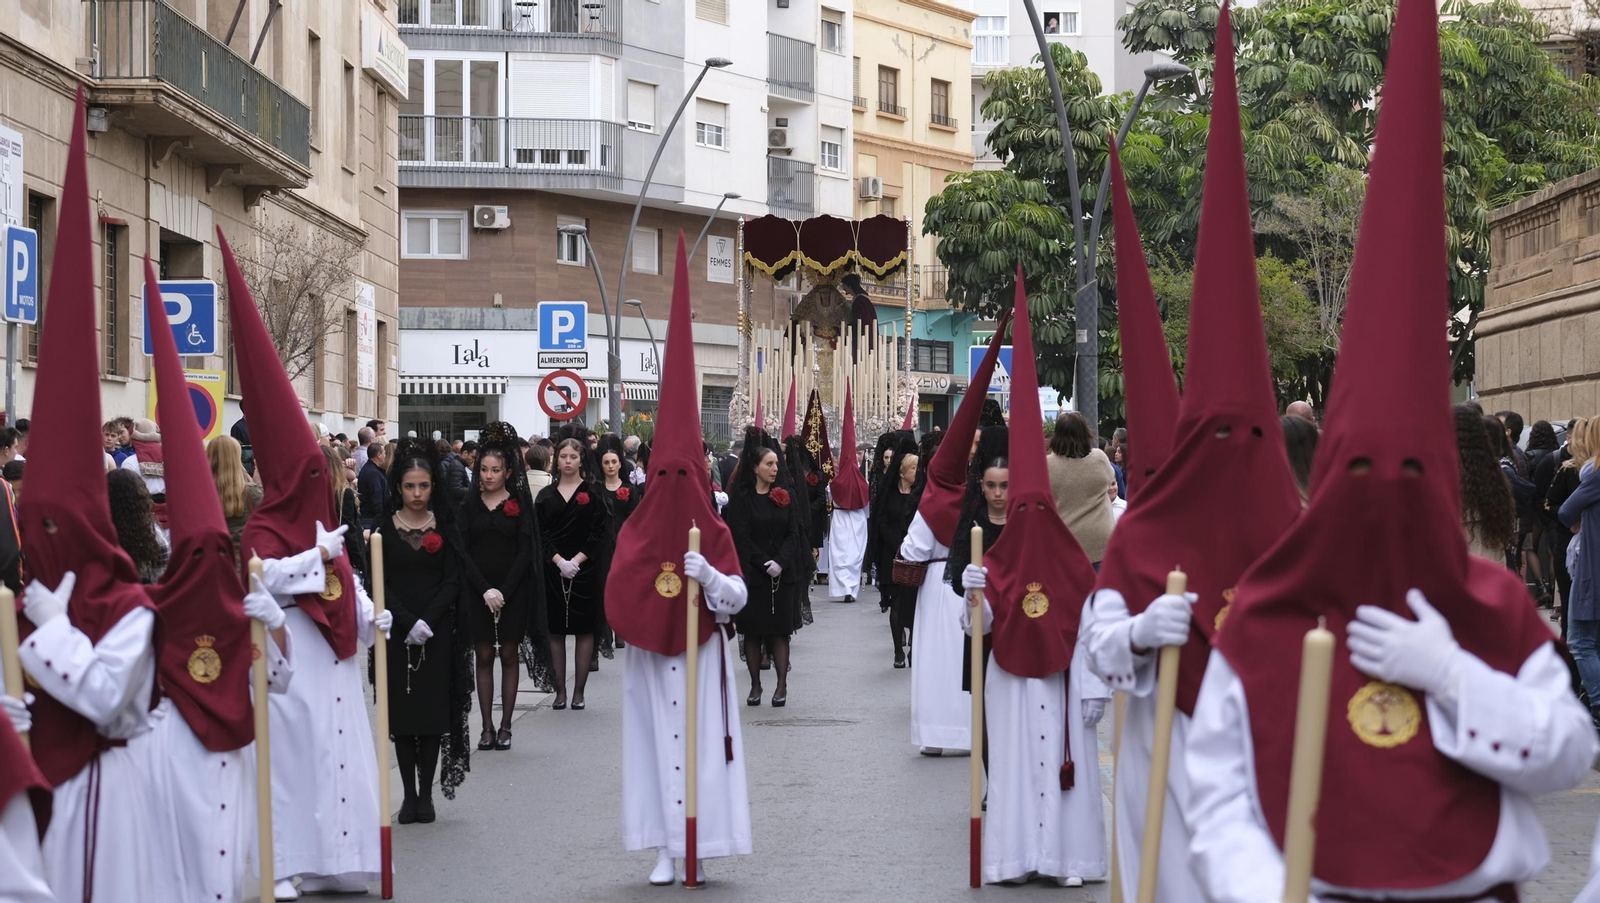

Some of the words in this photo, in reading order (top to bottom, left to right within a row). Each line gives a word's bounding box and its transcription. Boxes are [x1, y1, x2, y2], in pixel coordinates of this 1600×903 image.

[12, 240, 29, 305] P
[710, 256, 731, 268] FEMMES
[19, 294, 34, 307] MOTOS
[551, 310, 575, 345] P
[452, 339, 490, 368] Lalá
